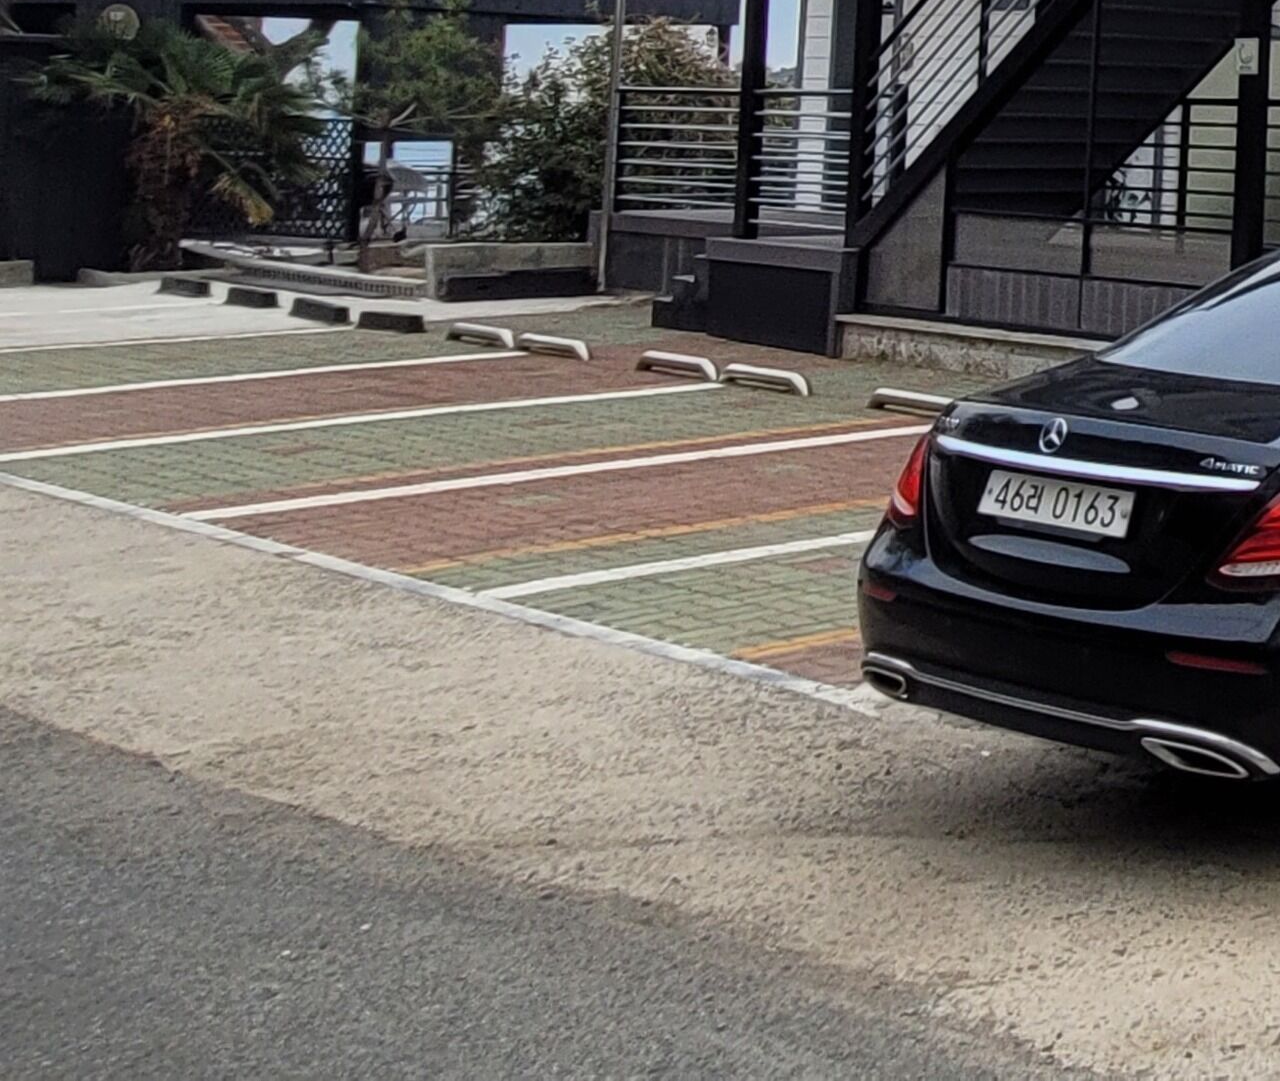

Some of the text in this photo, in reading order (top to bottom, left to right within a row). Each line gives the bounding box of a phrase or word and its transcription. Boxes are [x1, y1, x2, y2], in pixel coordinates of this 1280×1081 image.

[1200, 457, 1260, 475] 4MATIC
[994, 478, 1120, 528] 46라 0163
